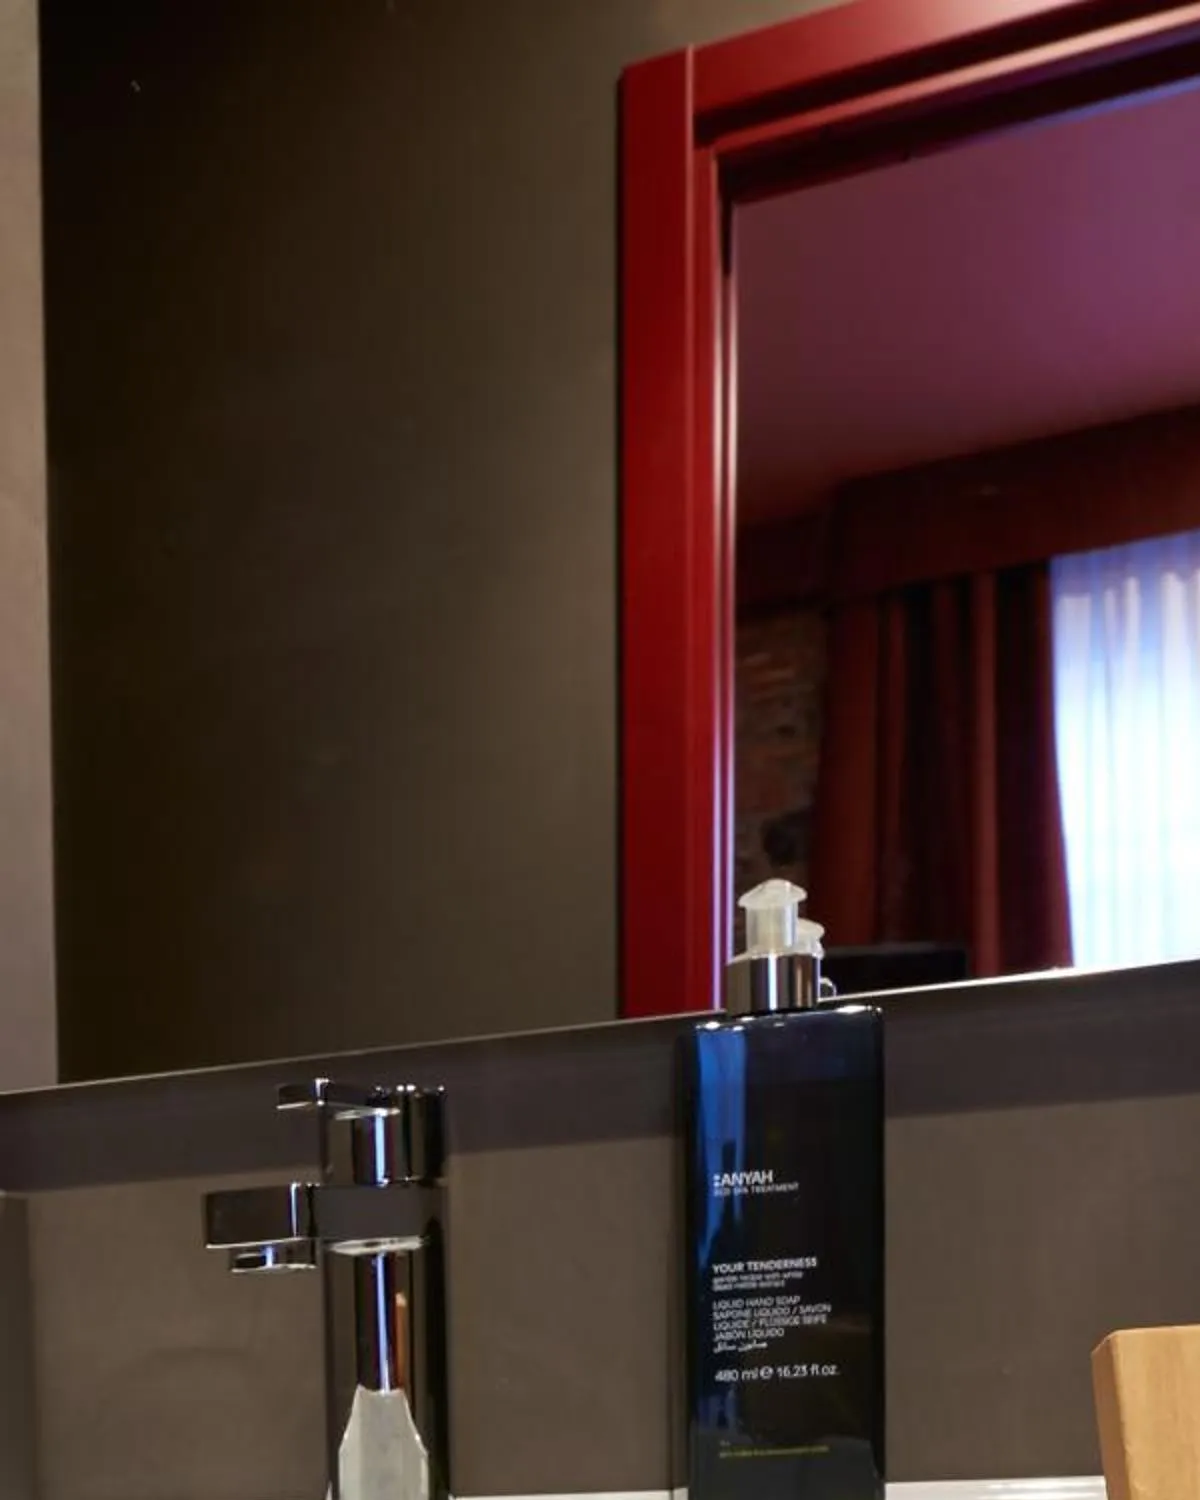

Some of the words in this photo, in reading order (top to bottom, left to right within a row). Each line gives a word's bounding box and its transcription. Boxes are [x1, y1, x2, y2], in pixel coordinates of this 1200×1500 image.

[712, 1262, 744, 1273] YOUR
[747, 1256, 817, 1270] TENDERNESS
[775, 1295, 800, 1304] SOAP
[714, 1368, 739, 1381] 480
[741, 1367, 758, 1380] ml
